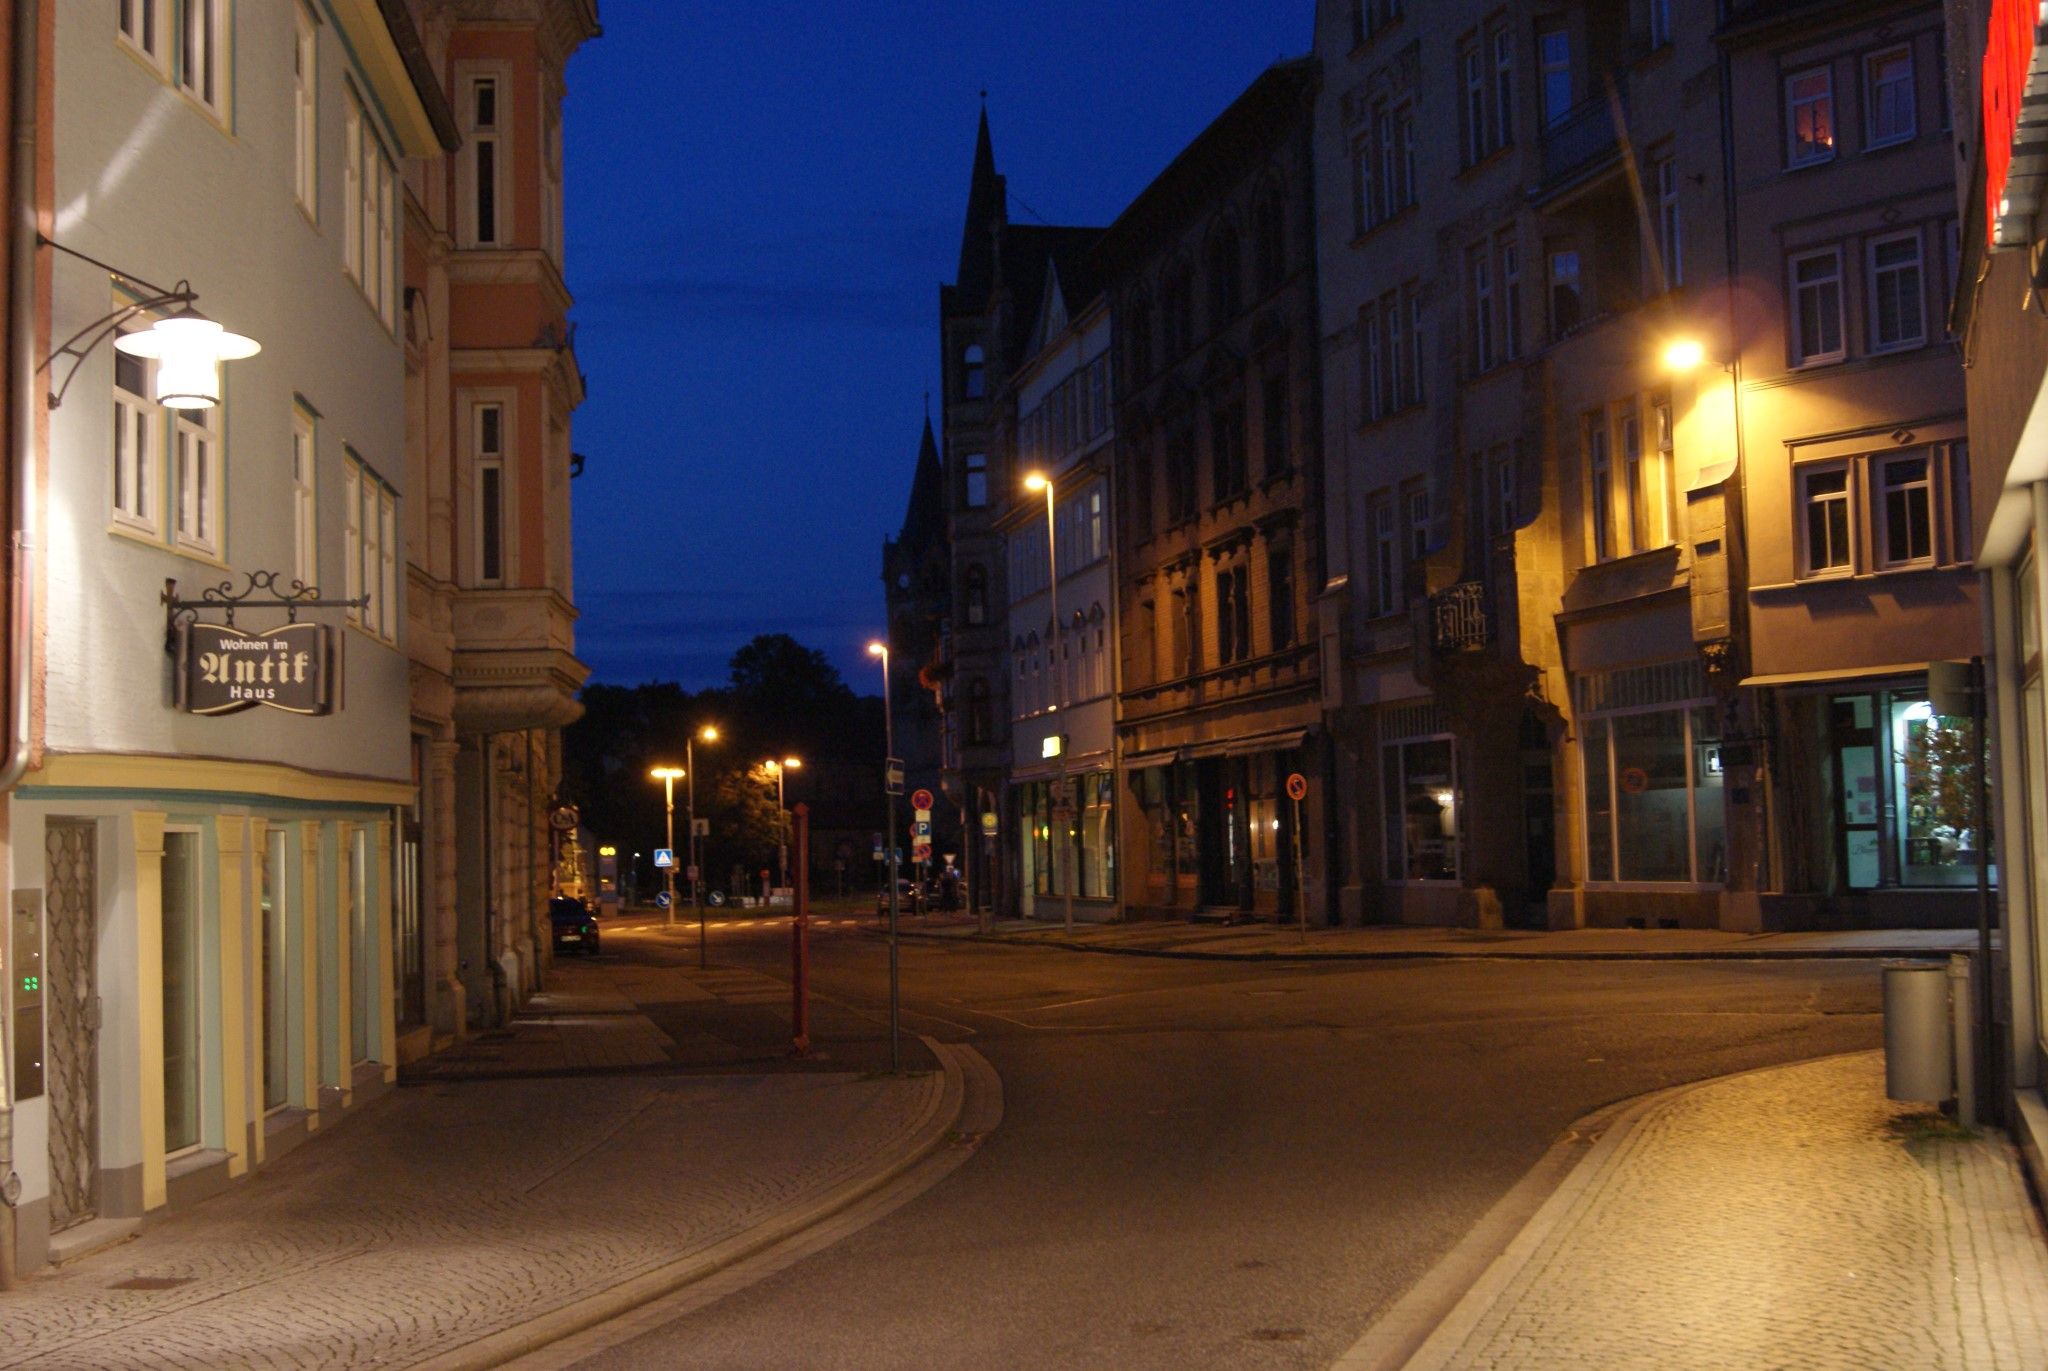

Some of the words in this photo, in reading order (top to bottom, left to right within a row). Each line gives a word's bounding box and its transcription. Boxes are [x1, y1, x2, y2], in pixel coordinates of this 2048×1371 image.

[220, 639, 269, 650] Wohnen
[273, 639, 288, 650] im
[200, 651, 309, 684] Antik
[230, 686, 276, 699] Haus
[919, 823, 928, 834] P
